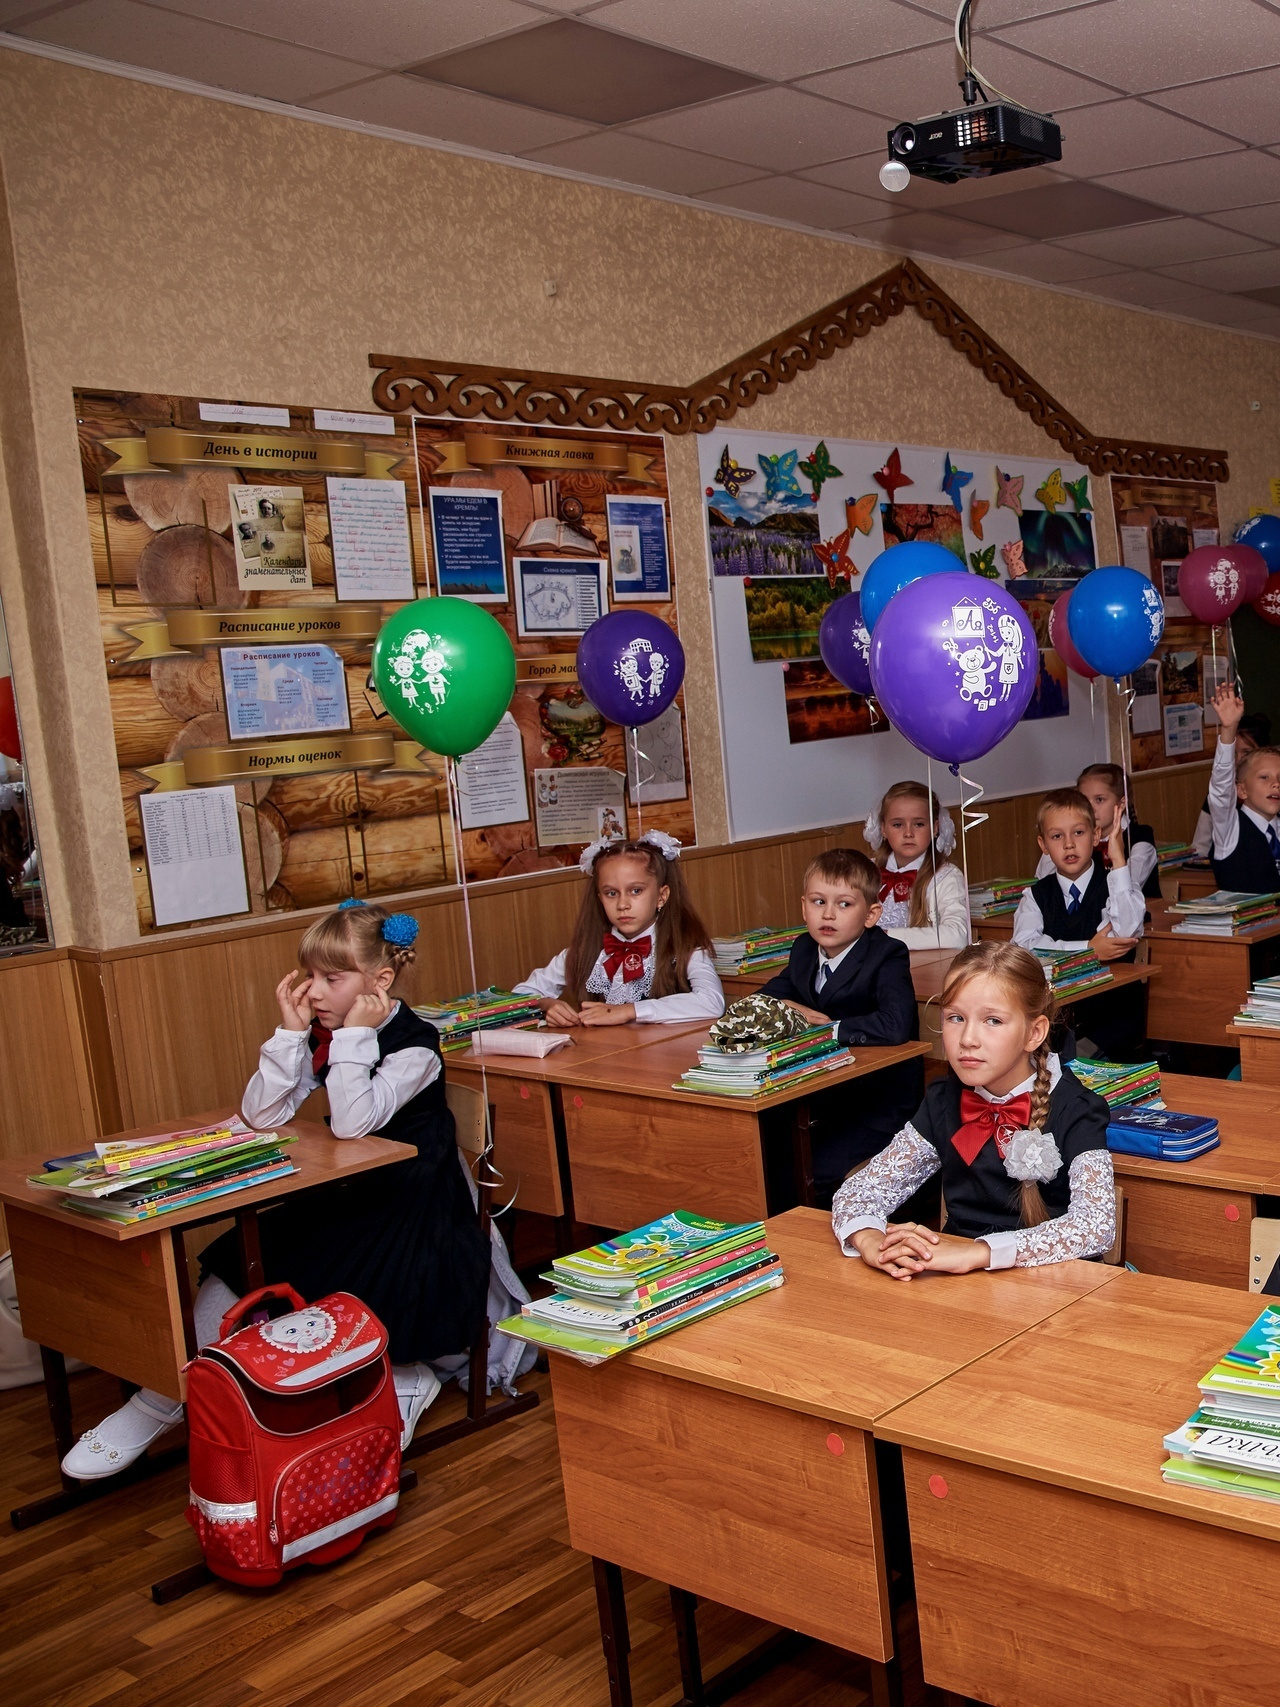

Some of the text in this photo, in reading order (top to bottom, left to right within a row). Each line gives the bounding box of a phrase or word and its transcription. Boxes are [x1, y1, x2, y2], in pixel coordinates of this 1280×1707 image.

[204, 442, 318, 462] День в истории
[505, 444, 594, 460] Книжная лавка
[263, 556, 304, 568] Календарь
[244, 568, 308, 578] знаменательных
[290, 574, 306, 584] дат
[218, 620, 341, 633] Расписание уроков
[529, 664, 556, 677] Город
[248, 750, 342, 768] Нормы оценок
[713, 1278, 729, 1287] Музыка
